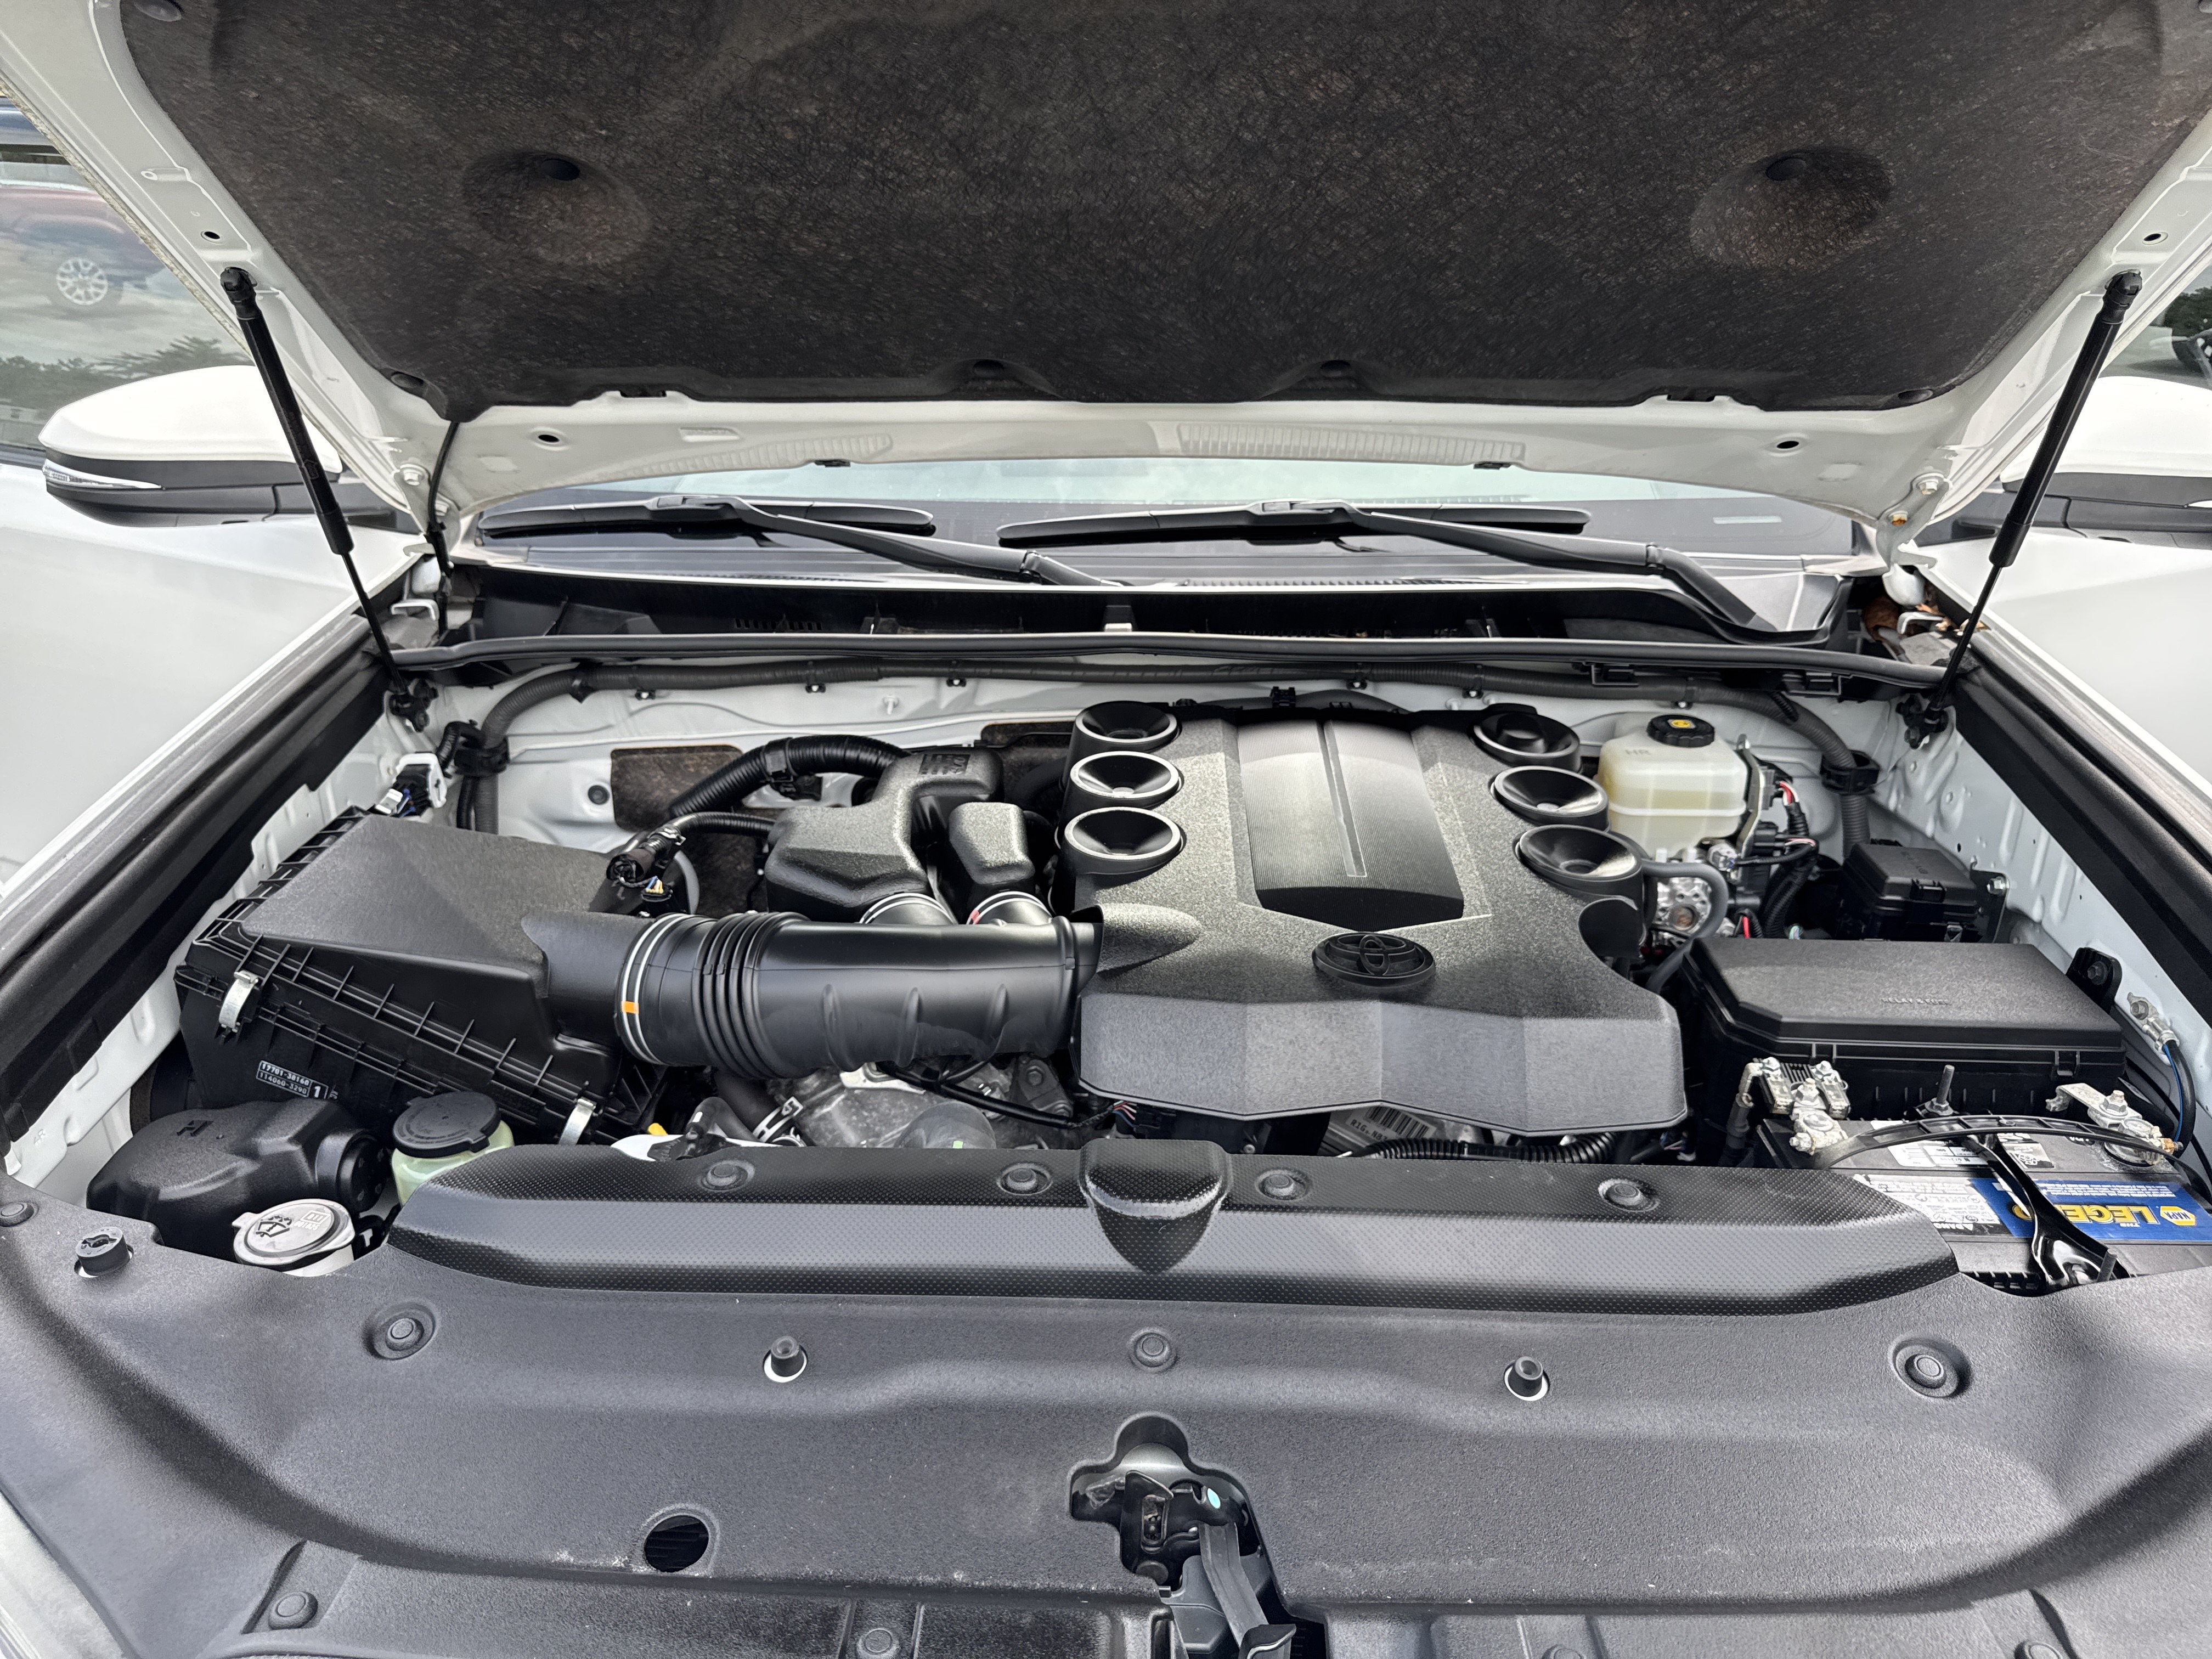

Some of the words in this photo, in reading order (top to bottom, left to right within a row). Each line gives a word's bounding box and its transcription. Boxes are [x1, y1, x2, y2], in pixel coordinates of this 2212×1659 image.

[259, 1072, 307, 1095] 114060-3290
[262, 1063, 310, 1086] 17701-38160
[313, 1085, 321, 1098] 1
[2163, 1211, 2191, 1220] NAPA
